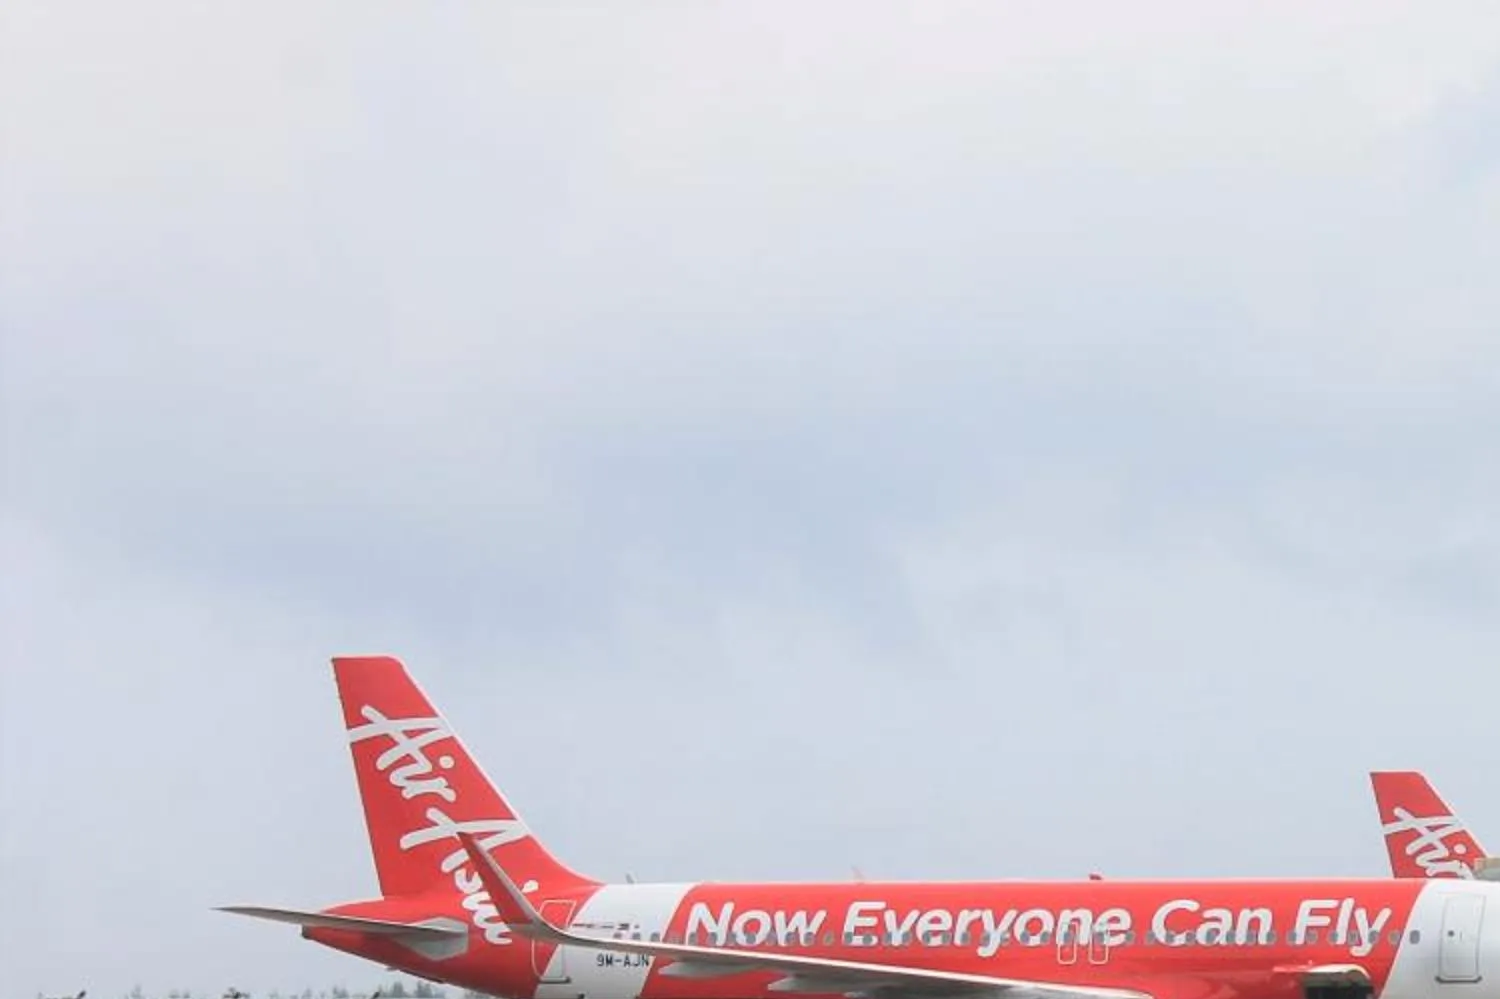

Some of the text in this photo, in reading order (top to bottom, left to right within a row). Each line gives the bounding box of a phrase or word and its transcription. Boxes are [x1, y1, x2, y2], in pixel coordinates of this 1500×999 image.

[348, 704, 457, 801] Air
[1382, 806, 1475, 879] Air
[596, 953, 650, 968] 9M-AJN
[685, 898, 1392, 957] Now Everyone Can Fly
